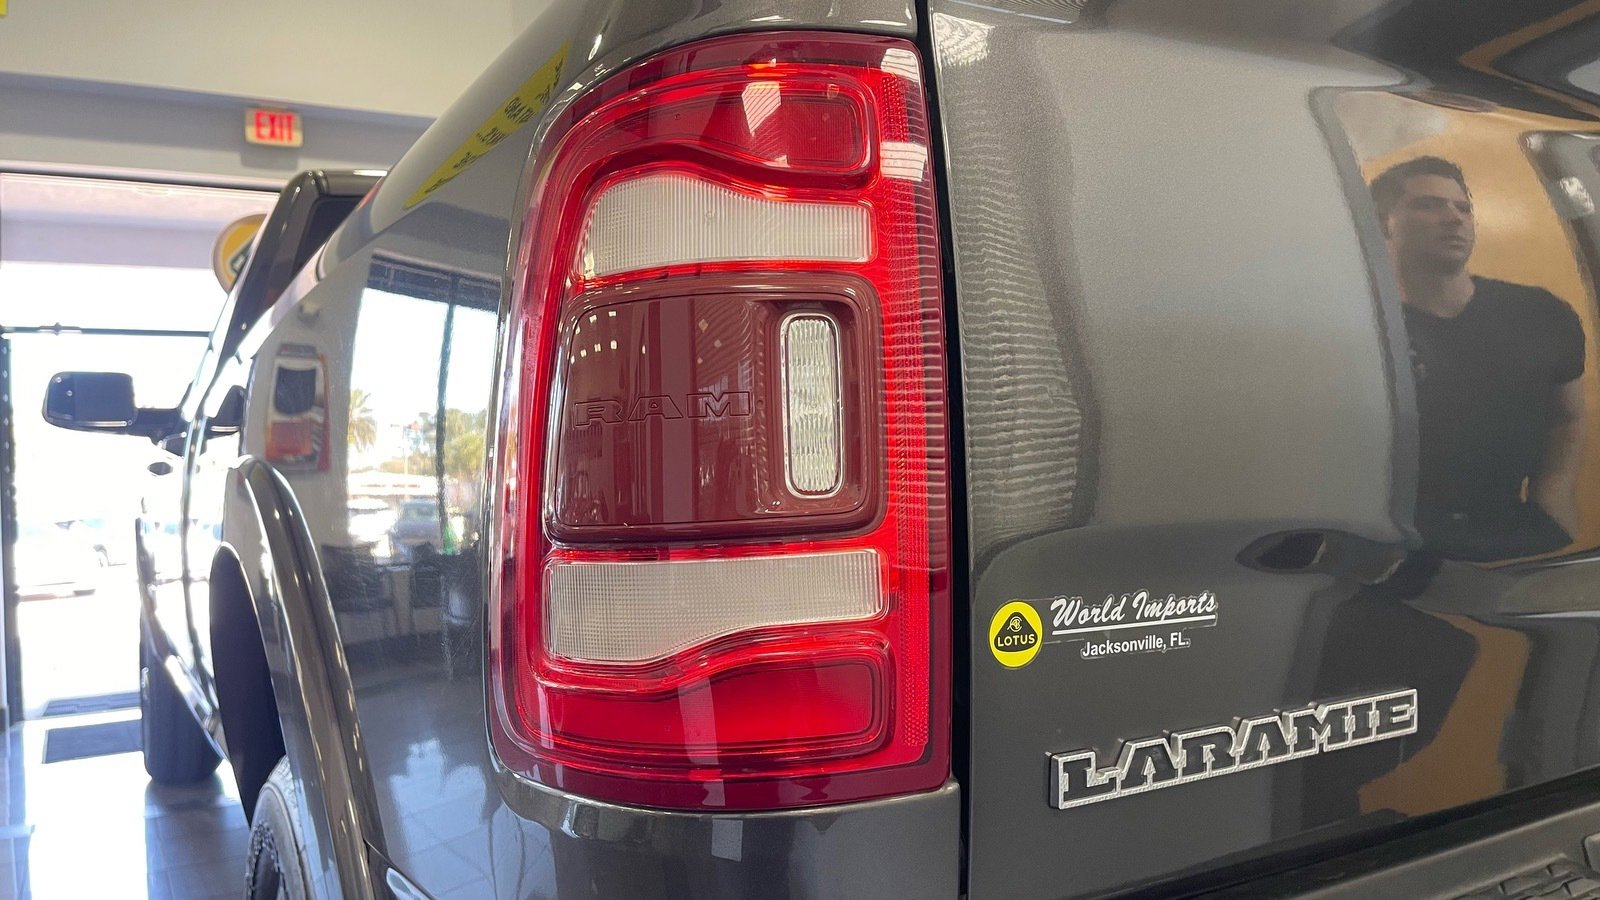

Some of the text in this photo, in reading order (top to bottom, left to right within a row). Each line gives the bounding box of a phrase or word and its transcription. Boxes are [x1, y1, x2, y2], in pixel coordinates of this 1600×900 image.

[255, 111, 294, 142] EXIT
[573, 391, 752, 427] RAM
[1050, 596, 1127, 628] World
[1132, 590, 1216, 622] Imports
[997, 633, 1035, 647] LOTUS
[1083, 632, 1190, 657] Jacksonville, FL.
[1050, 688, 1418, 810] LARAMIE
